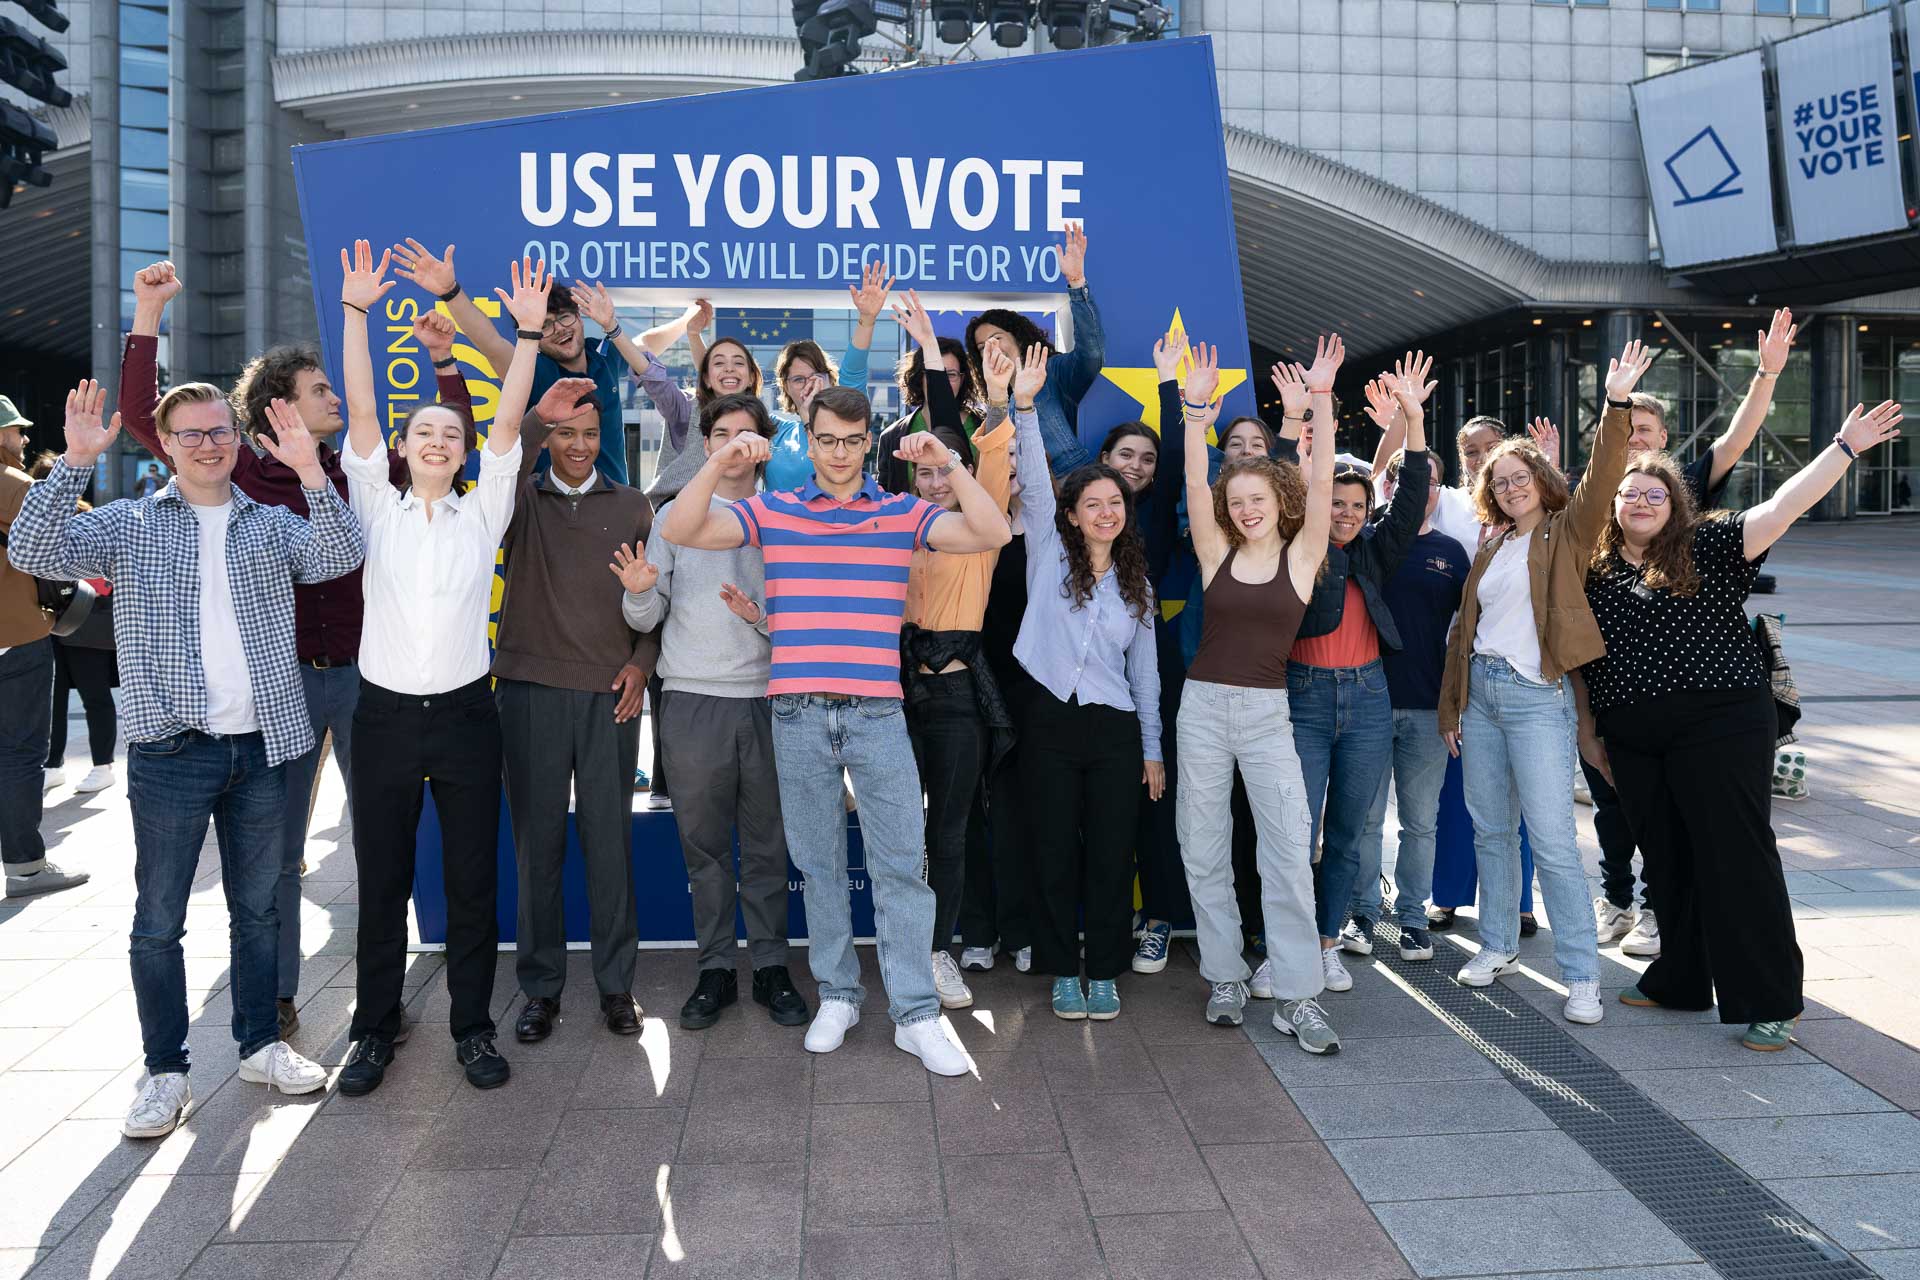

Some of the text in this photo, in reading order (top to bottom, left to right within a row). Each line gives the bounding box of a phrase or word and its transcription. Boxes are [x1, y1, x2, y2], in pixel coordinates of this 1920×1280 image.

[1796, 113, 1882, 152] YOUR
[1799, 140, 1884, 179] VOTE
[520, 152, 1084, 231] USE YOUR VOTE
[523, 240, 570, 278] OR
[580, 240, 710, 279] OTHERS
[722, 241, 805, 279] WILL
[948, 244, 1010, 282] FOR
[1019, 245, 1062, 283] YO
